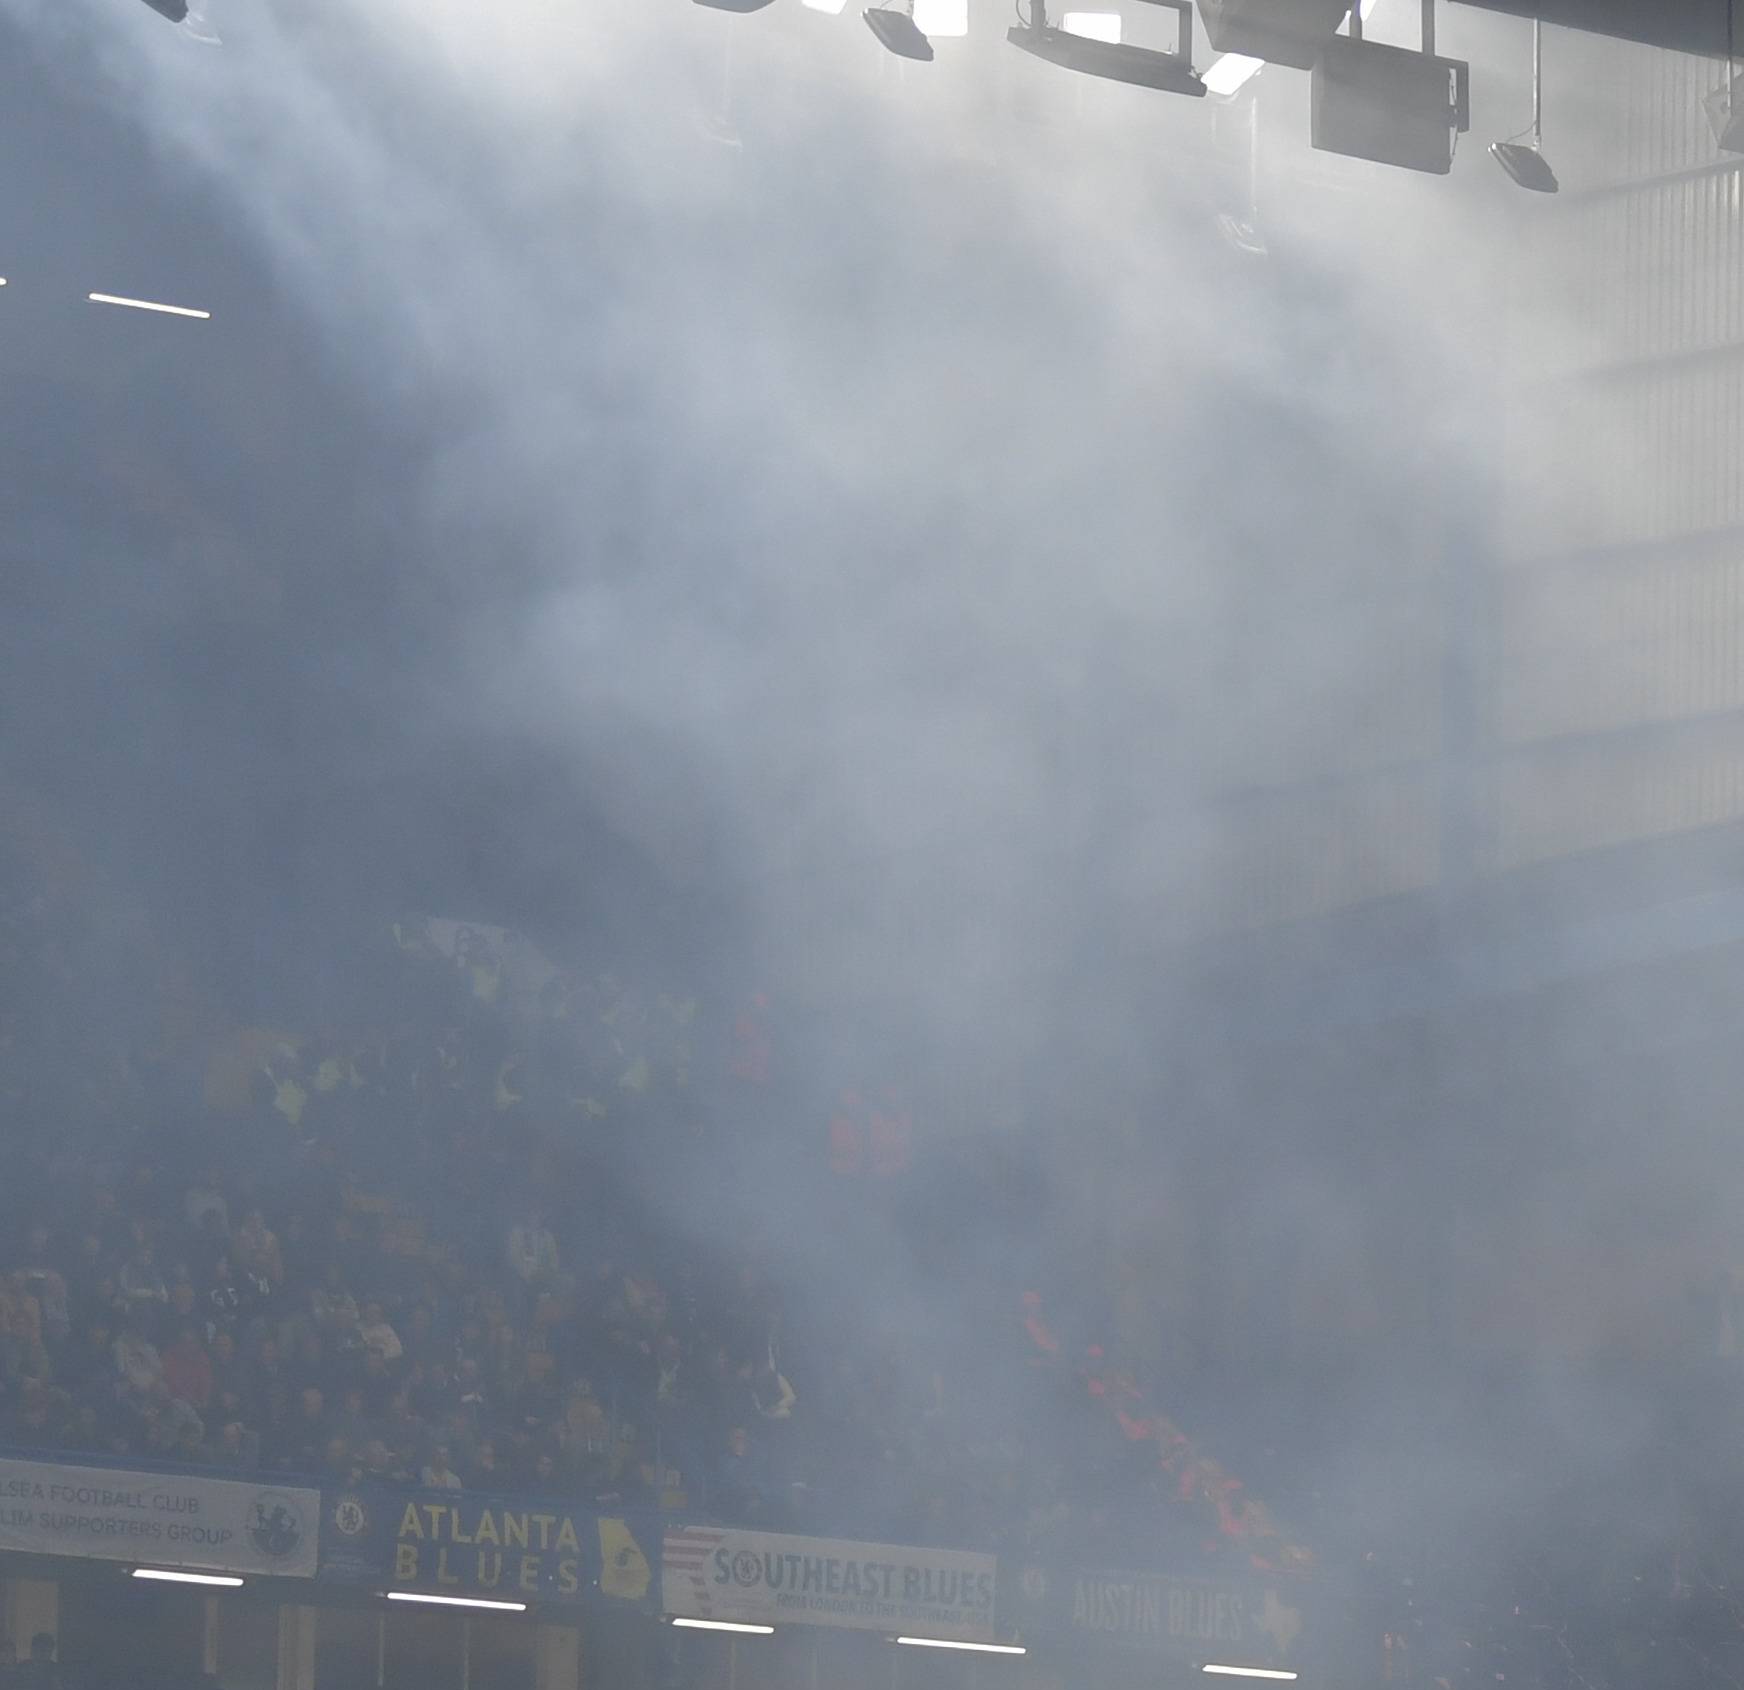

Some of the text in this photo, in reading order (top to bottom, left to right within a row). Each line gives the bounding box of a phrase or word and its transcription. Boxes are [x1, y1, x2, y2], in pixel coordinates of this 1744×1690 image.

[50, 1484, 148, 1511] FOOTBALL
[152, 1493, 201, 1513] CLUB
[39, 1512, 163, 1541] SUPPORTERS
[167, 1525, 233, 1546] GROUP
[398, 1501, 581, 1553] ATLANTA
[393, 1543, 581, 1595] BLUES
[713, 1547, 993, 1610] SOUTHEAST BLUES
